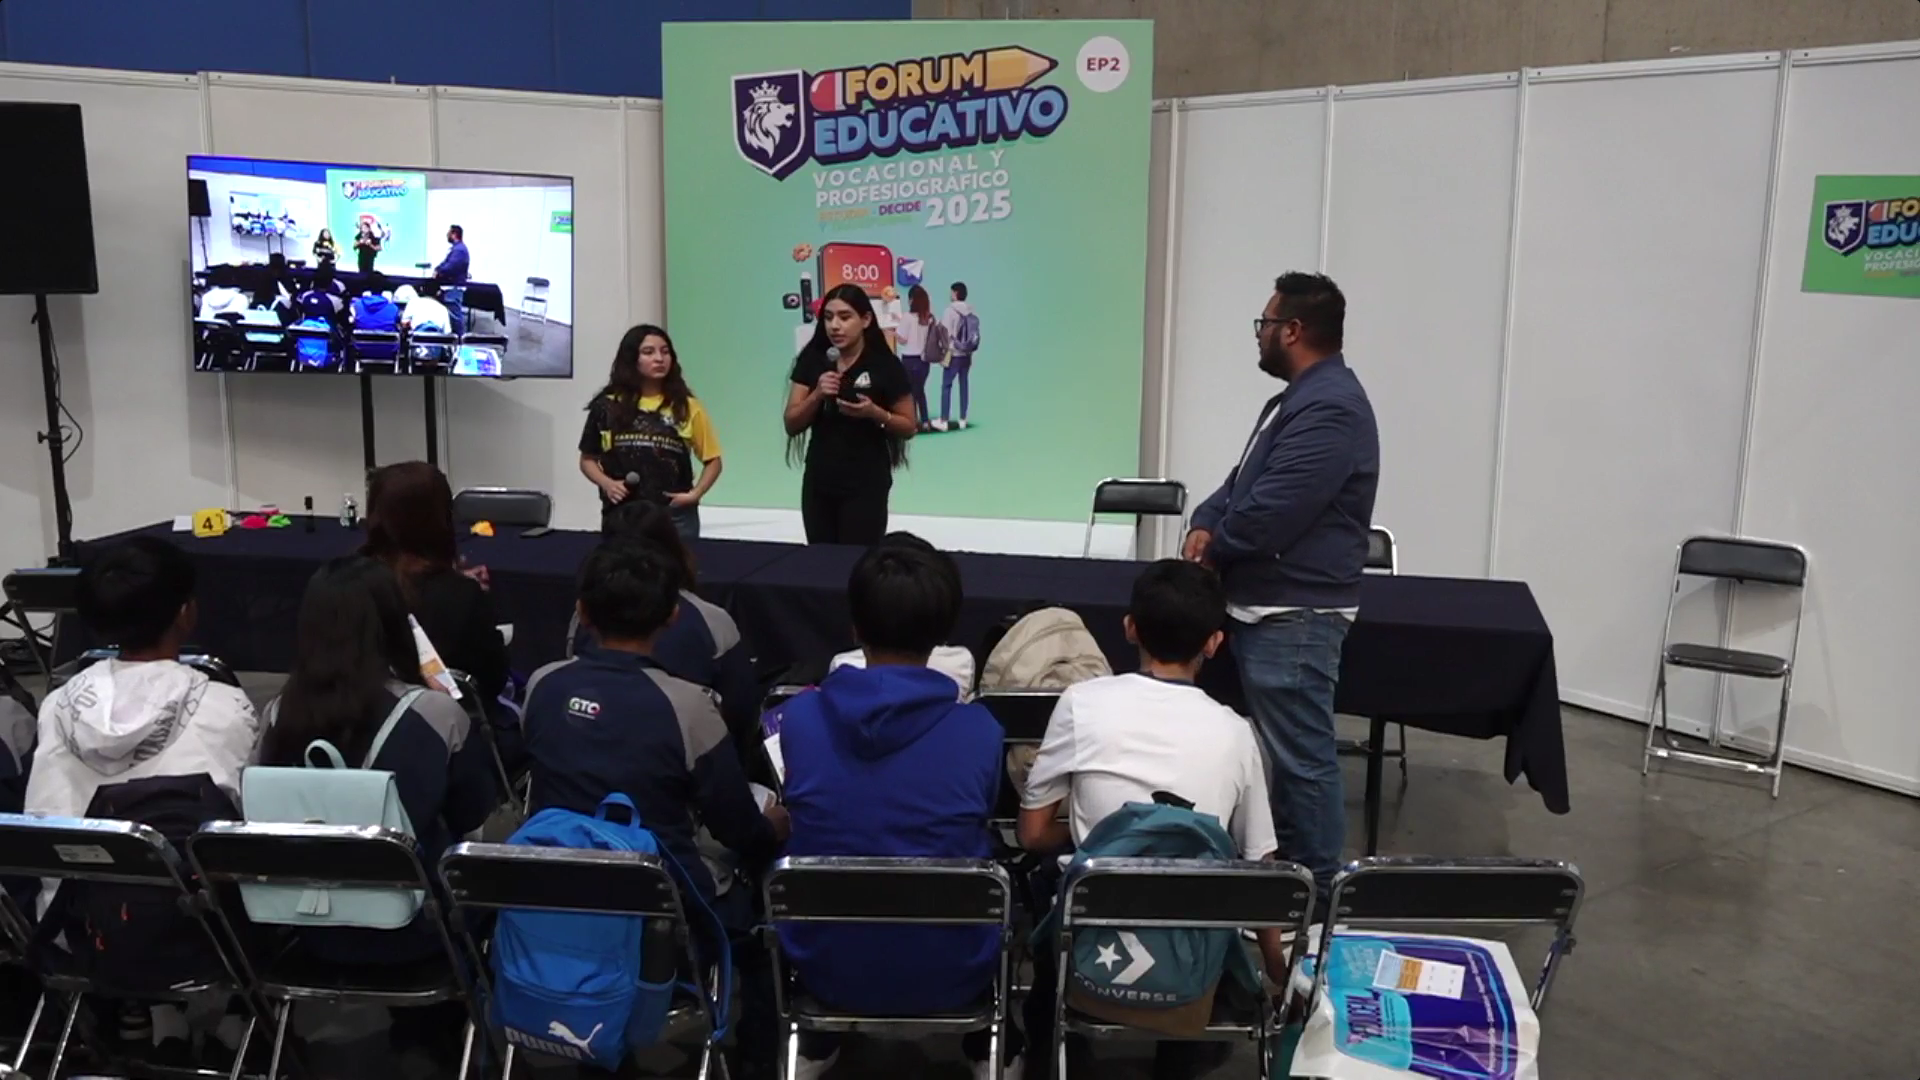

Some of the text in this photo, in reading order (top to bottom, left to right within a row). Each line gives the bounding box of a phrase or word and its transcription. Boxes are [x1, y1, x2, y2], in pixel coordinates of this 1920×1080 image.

[845, 52, 985, 105] FORUM
[1087, 57, 1121, 71] EP2
[813, 89, 1065, 155] EDUCATIVO
[813, 150, 1005, 189] VOCACIONAL Y
[815, 169, 1009, 208] PROFESIOGRÁFICO
[878, 200, 921, 216] DECIDE
[925, 189, 1012, 228] 2025
[1866, 221, 1920, 245] EDU
[842, 264, 880, 280] 8:00
[202, 516, 214, 531] 4
[568, 696, 601, 715] GTO
[1074, 971, 1177, 1002] CONVERSE
[504, 1026, 583, 1060] PUMA
